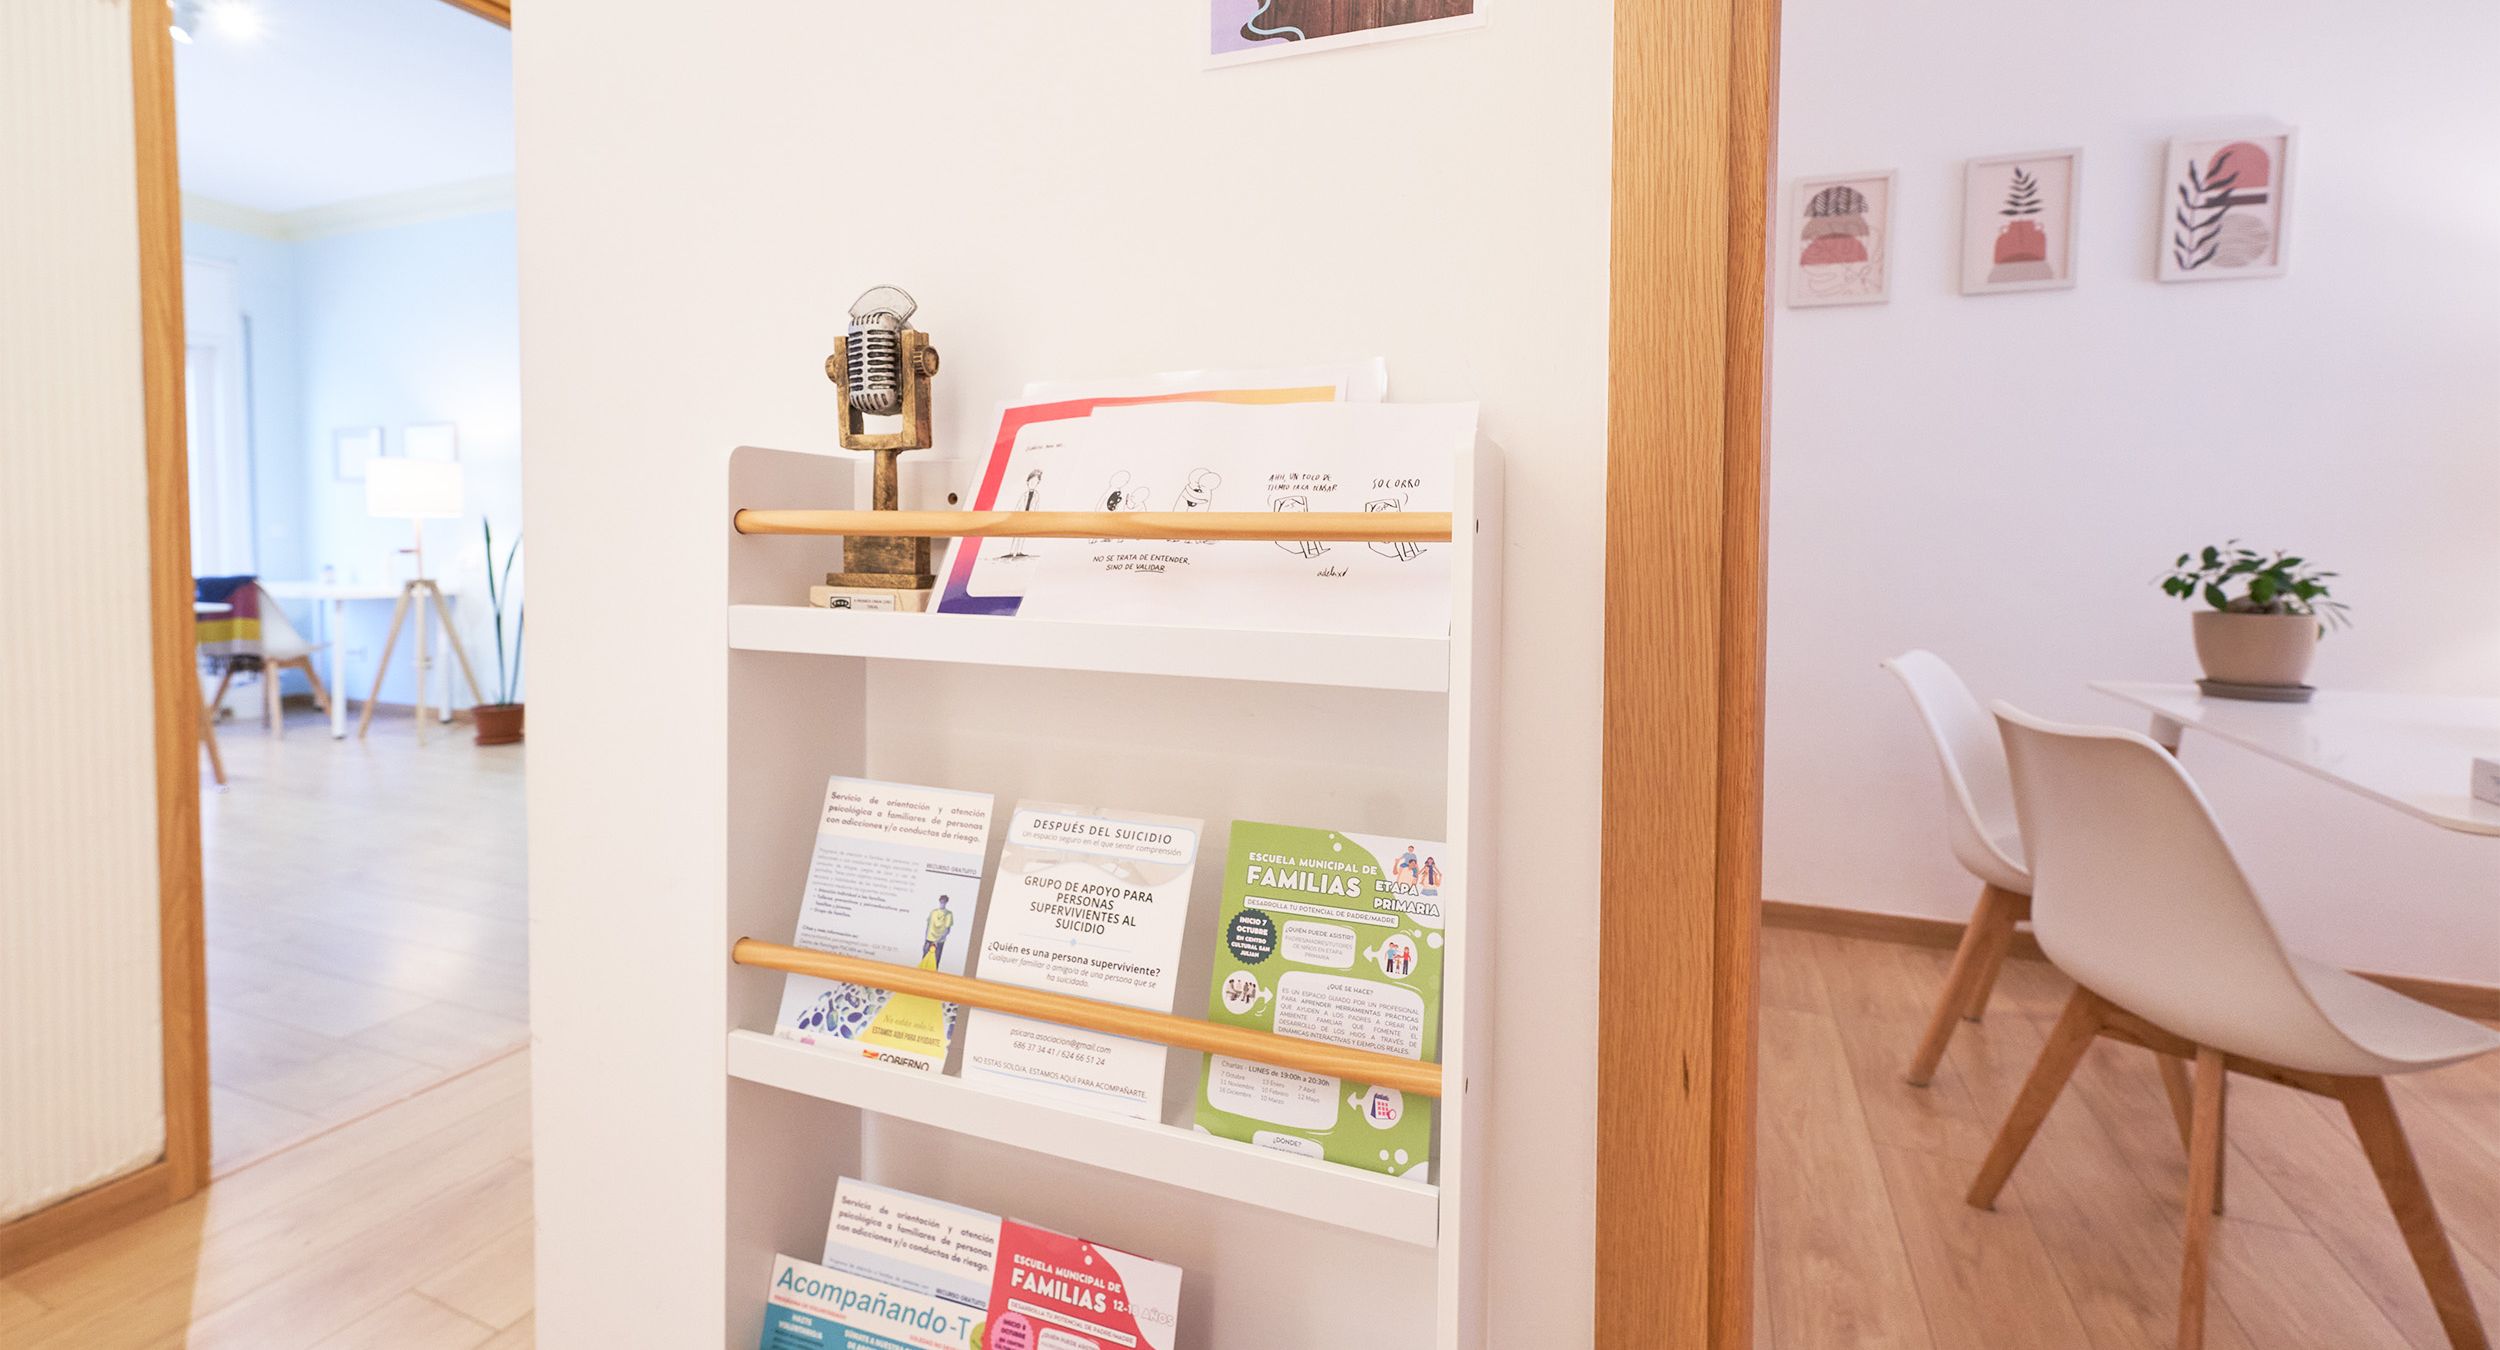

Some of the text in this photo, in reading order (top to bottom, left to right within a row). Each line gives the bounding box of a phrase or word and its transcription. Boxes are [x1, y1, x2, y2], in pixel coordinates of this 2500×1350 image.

[1372, 479, 1421, 490] SOCORRO
[1150, 554, 1190, 565] ENTENDER,
[828, 804, 872, 817] psicológica
[888, 810, 926, 823] familiares
[931, 816, 941, 825] de
[946, 819, 983, 830] personas
[831, 791, 862, 803] Servicio
[869, 796, 879, 804] de
[887, 798, 930, 811] orientación
[951, 806, 985, 818] atención
[826, 816, 980, 843] con adicciones y/o conductas de riesgo.
[1034, 819, 1172, 845] DESPUÉS DEL SUICIDIO
[1033, 832, 1057, 842] espacio
[1059, 834, 1081, 844] seguro
[1093, 838, 1099, 846] el
[1101, 841, 1113, 849] que
[1115, 841, 1135, 850] sentir
[1136, 844, 1182, 857] comprensión
[1249, 852, 1378, 875] ESCUELA MUNICIPAL DE
[1024, 875, 1153, 903] GRUPO DE APOYO PARA
[1246, 866, 1361, 897] FAMILIAS
[1375, 880, 1419, 896] ETAPA
[1057, 893, 1114, 910] PERSONAS
[1247, 898, 1289, 910] DESARROLLA
[1299, 905, 1334, 916] POTENCIAL
[1336, 910, 1345, 918] DE
[1346, 911, 1395, 924] PADRE/MADRE
[1373, 898, 1440, 917] PRIMARIA
[1030, 902, 1137, 927] SUPERVIVIENTES AL
[1056, 918, 1105, 935] SUICIDIO
[1240, 916, 1261, 925] INICIO
[1236, 926, 1268, 936] OCTUBRE
[1245, 936, 1266, 944] CENTRO
[1231, 941, 1257, 950] CULTURAL
[988, 941, 1161, 977] ¿Quién es una persona superviviente?
[1019, 958, 1044, 968] familiar
[1090, 971, 1103, 979] una
[1105, 974, 1133, 985] persona
[1134, 978, 1147, 988] que
[879, 1054, 929, 1071] GOBIERNO
[973, 1055, 983, 1063] NO
[1029, 1067, 1059, 1079] ESTAMOS
[1078, 1078, 1094, 1087] PARA
[1248, 1066, 1270, 1075] LUNES
[1280, 1072, 1301, 1080] 19:00h
[1308, 1076, 1329, 1086] 20:30h
[842, 1196, 994, 1244] Servicio de orientación y atención
[839, 1210, 882, 1228] psicológica
[897, 1224, 936, 1241] familiares
[941, 1235, 951, 1246] de
[956, 1242, 992, 1258] personas
[837, 1223, 990, 1272] con adicciones y/o conductas de riesgo.
[1013, 1254, 1121, 1293] ESCUELA MUNICIPAL DE
[1011, 1268, 1107, 1313] FAMILIAS
